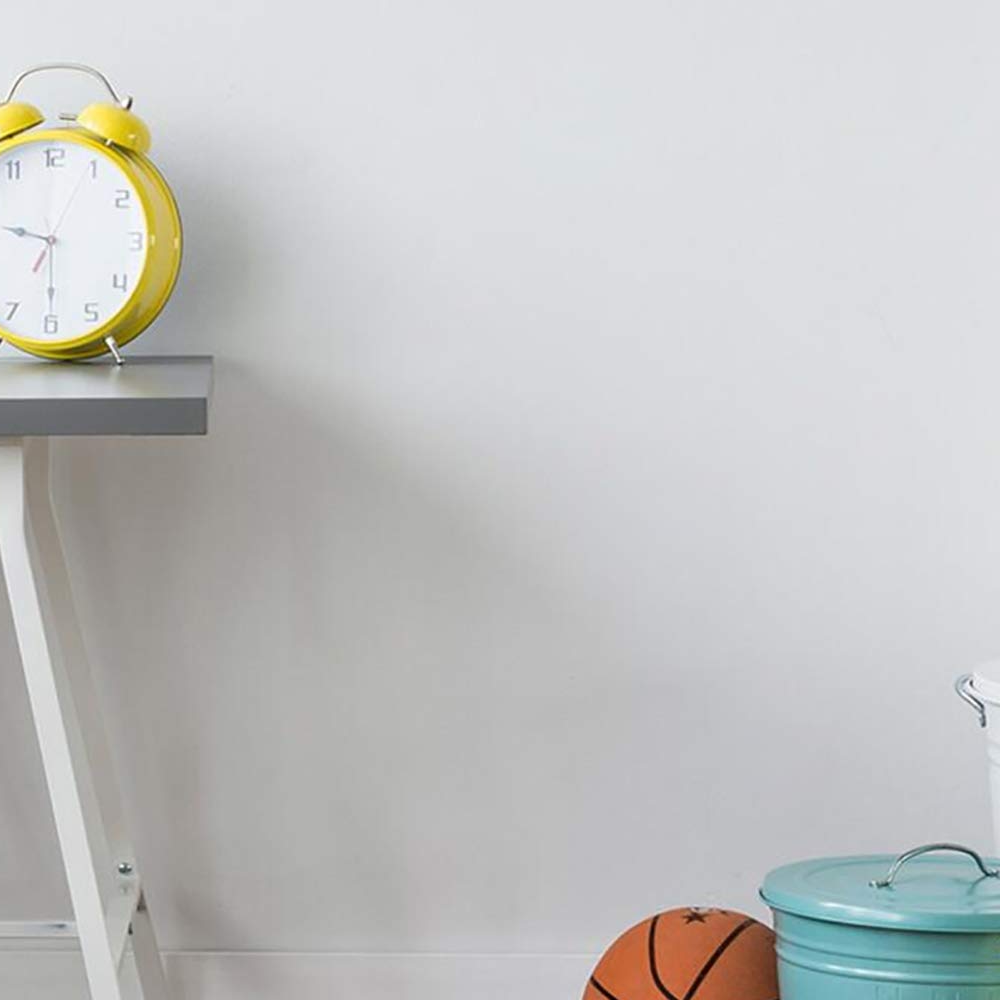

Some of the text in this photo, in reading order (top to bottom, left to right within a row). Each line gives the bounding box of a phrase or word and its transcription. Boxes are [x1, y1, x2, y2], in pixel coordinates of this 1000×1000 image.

[44, 148, 66, 168] 12
[6, 160, 21, 180] 11
[89, 160, 97, 179] 1
[115, 190, 130, 209] 2
[129, 232, 143, 251] 3
[112, 273, 128, 293] 4
[5, 302, 20, 321] 7
[84, 303, 99, 323] 5
[44, 315, 58, 334] 6
